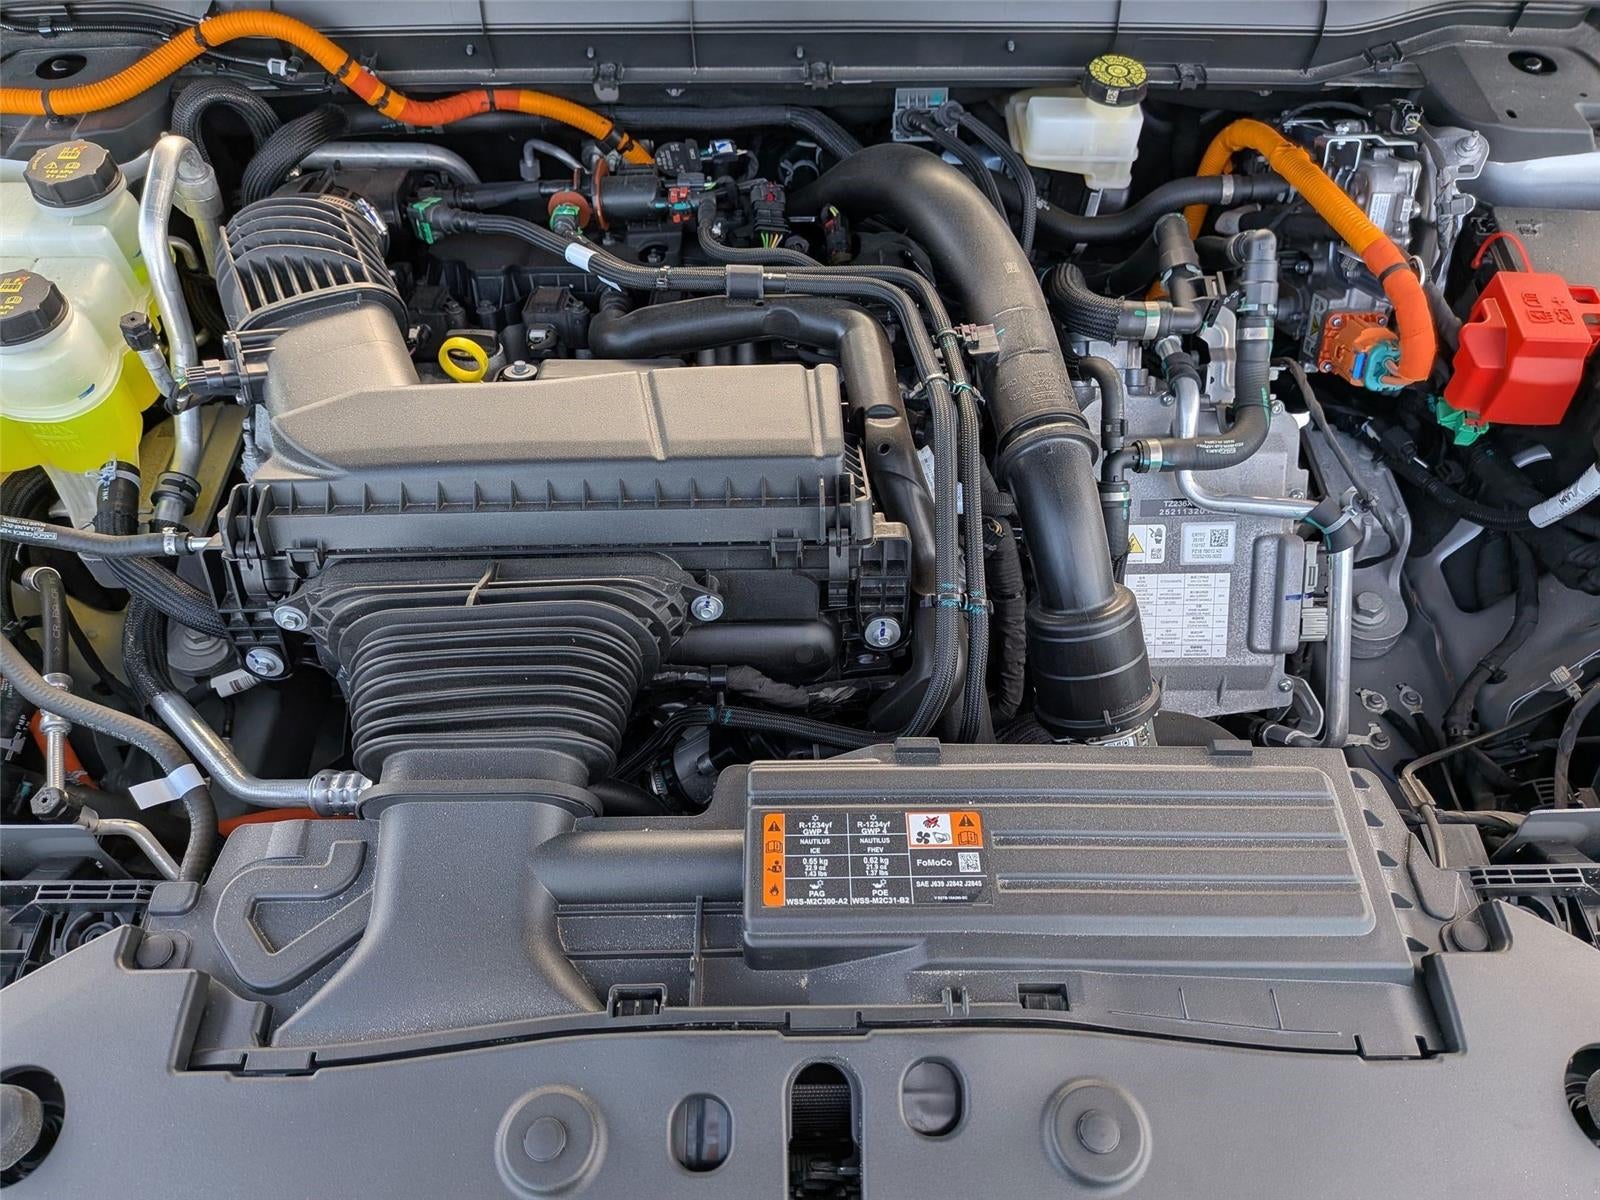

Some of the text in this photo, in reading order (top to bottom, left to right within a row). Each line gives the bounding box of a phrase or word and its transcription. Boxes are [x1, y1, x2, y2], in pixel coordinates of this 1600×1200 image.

[799, 821, 832, 830] R-1234yf
[857, 821, 890, 829] R-1234yf
[819, 857, 828, 866] kg
[879, 856, 889, 865] kg
[916, 858, 953, 867] FoMoCo
[916, 880, 929, 888] SAE
